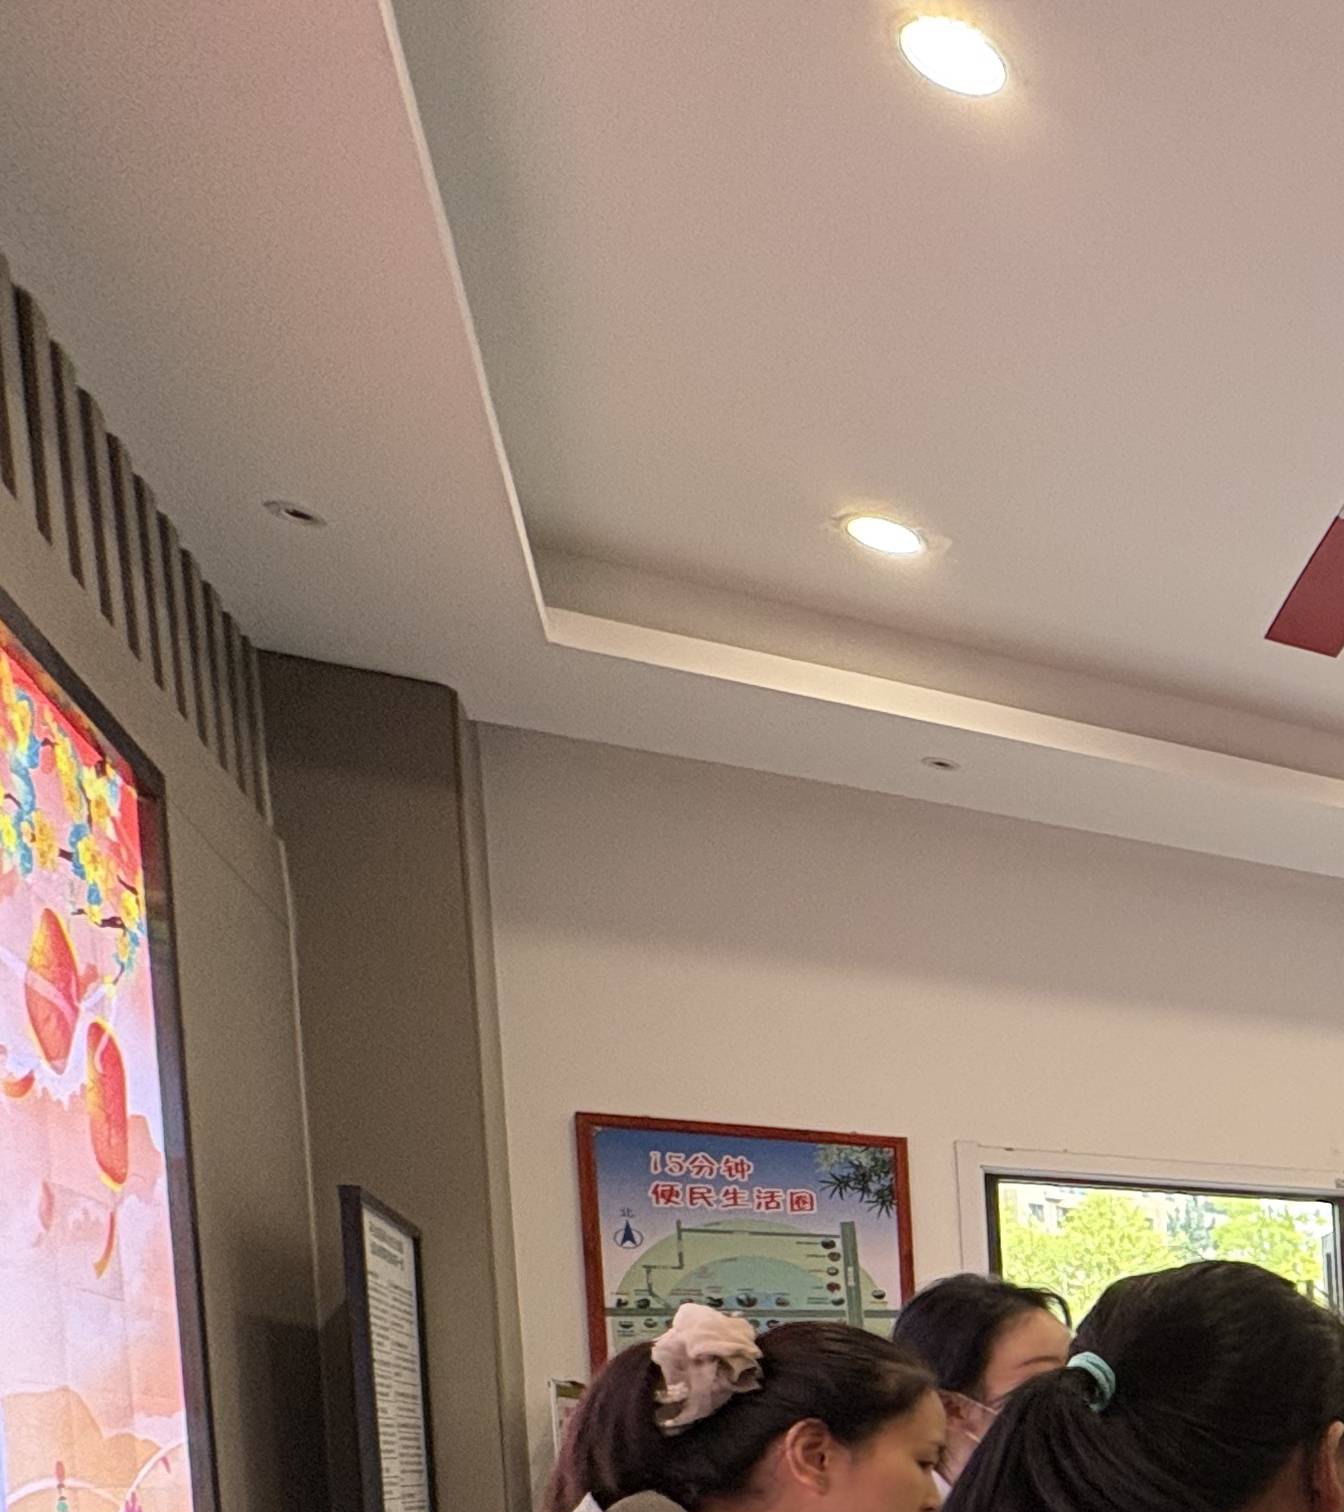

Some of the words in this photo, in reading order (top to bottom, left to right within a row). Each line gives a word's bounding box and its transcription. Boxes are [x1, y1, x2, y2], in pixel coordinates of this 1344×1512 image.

[649, 1150, 753, 1181] 15分钟
[650, 1183, 818, 1213] 便民生活圈
